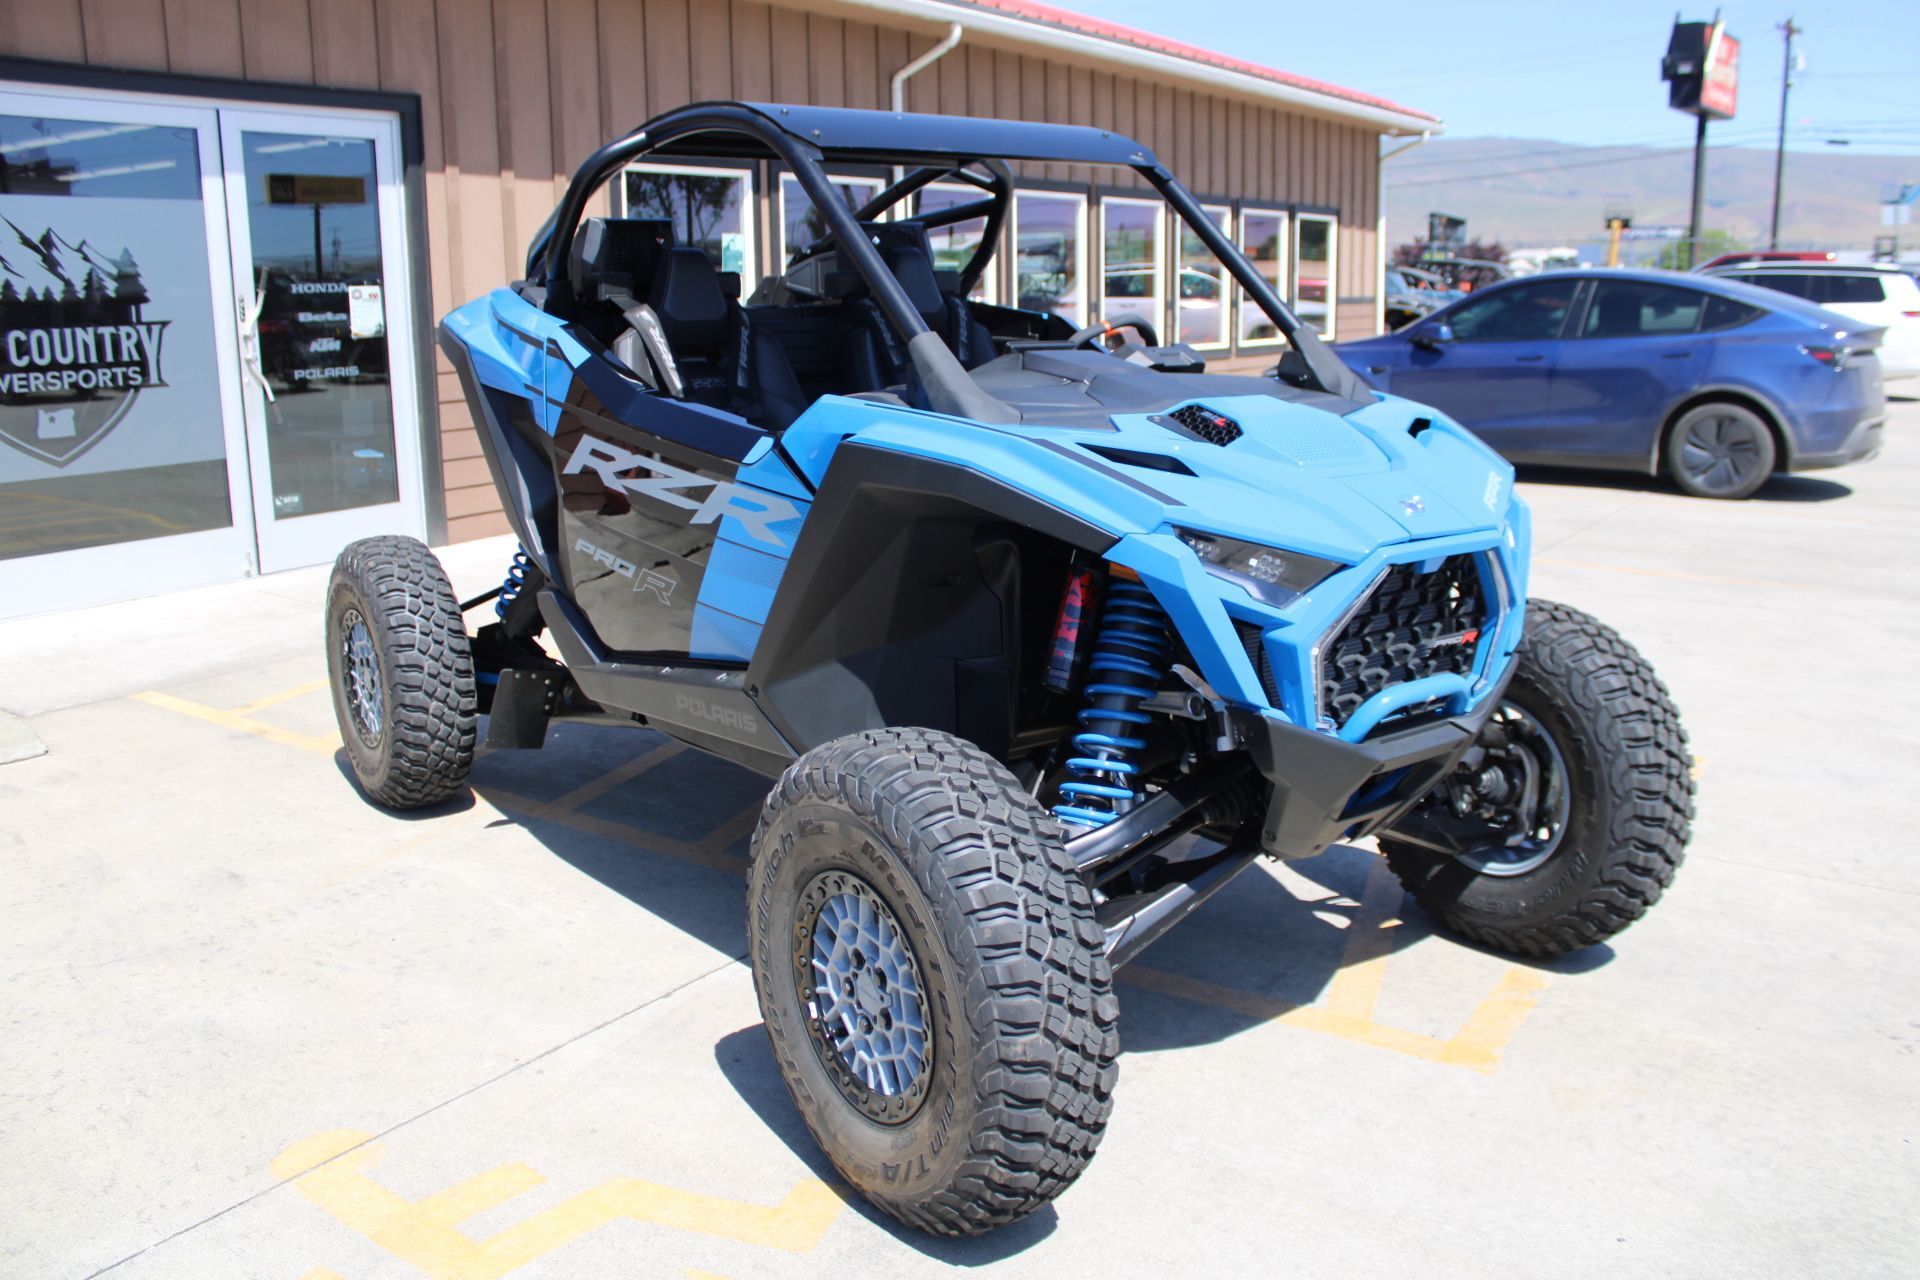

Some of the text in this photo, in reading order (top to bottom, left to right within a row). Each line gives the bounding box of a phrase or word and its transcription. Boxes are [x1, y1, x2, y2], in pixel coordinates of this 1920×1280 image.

[291, 282, 348, 294] HONDA
[8, 323, 163, 384] COUNTRY
[309, 337, 341, 352] KTM
[294, 365, 359, 380] POLARIS
[562, 434, 801, 548] RZR
[575, 538, 676, 606] PRO R
[675, 693, 758, 733] POLARIS
